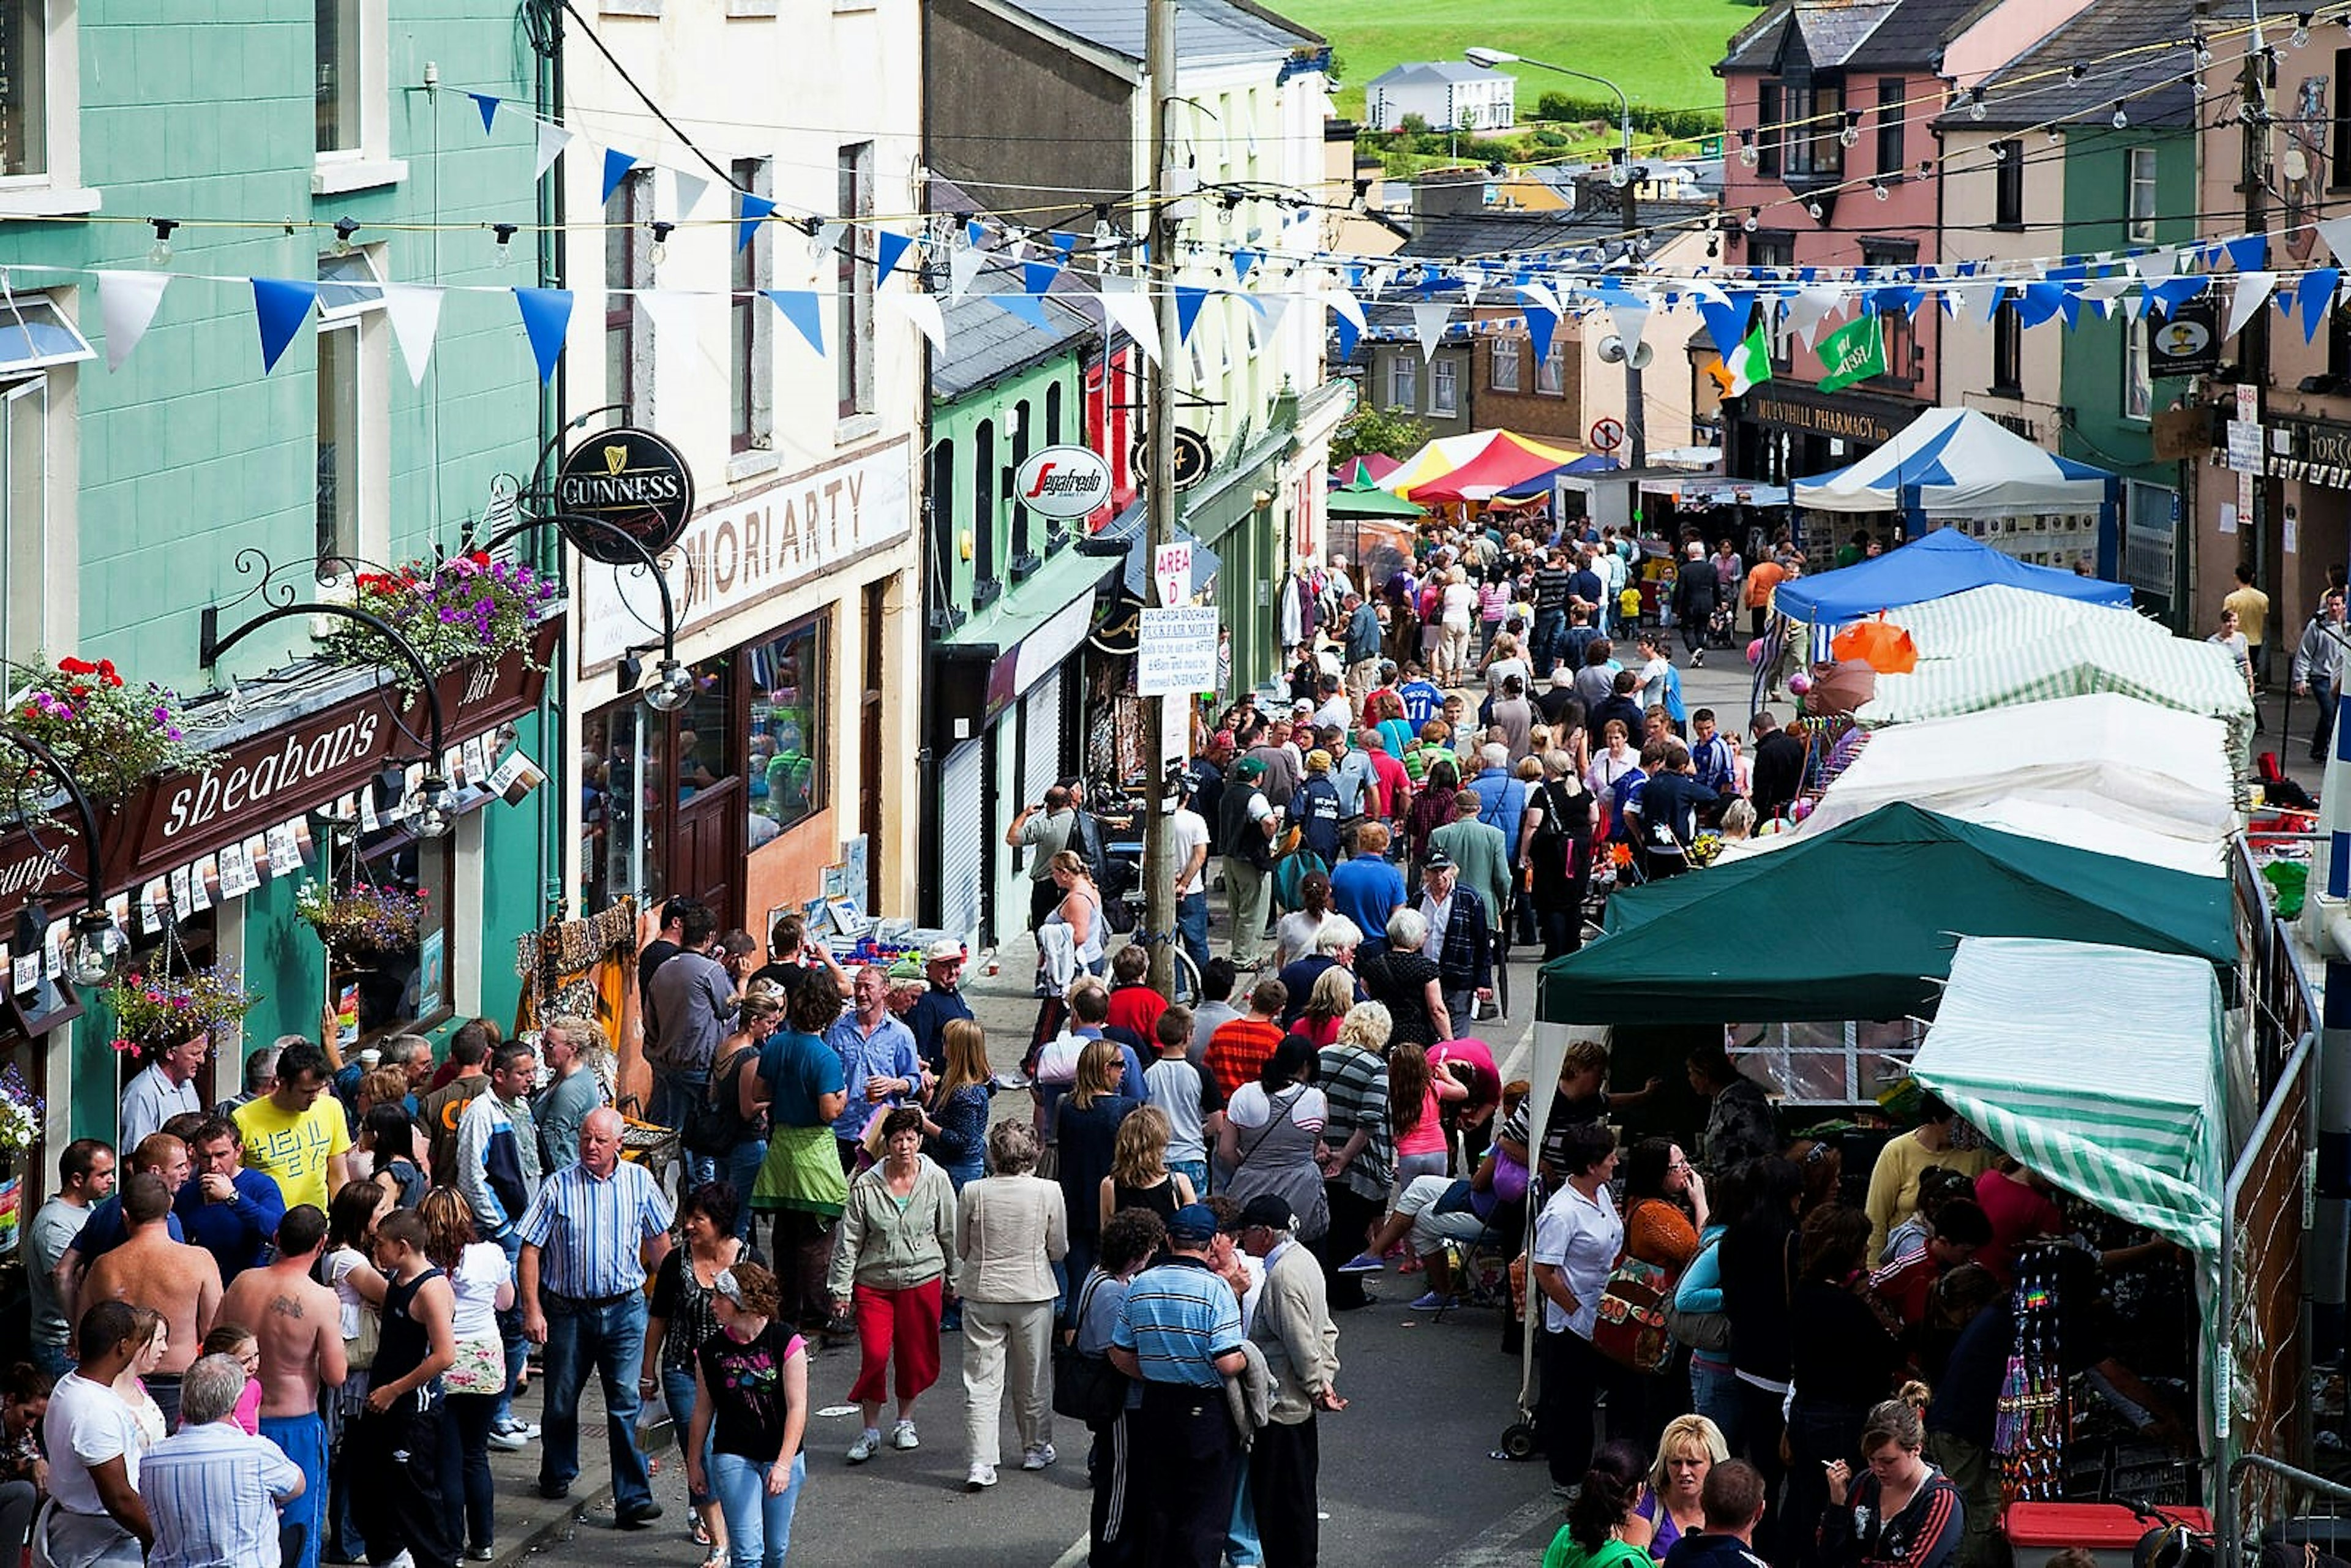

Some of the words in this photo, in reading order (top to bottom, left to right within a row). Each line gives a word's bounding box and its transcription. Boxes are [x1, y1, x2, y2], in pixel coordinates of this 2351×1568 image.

[1815, 409, 1874, 438] PHARMACY
[563, 475, 678, 505] GUINNESS
[1026, 462, 1101, 498] Segafredo
[1158, 549, 1190, 576] AREA
[1169, 582, 1178, 604] D
[1409, 699, 1427, 720] 11
[0, 844, 69, 896] unge
